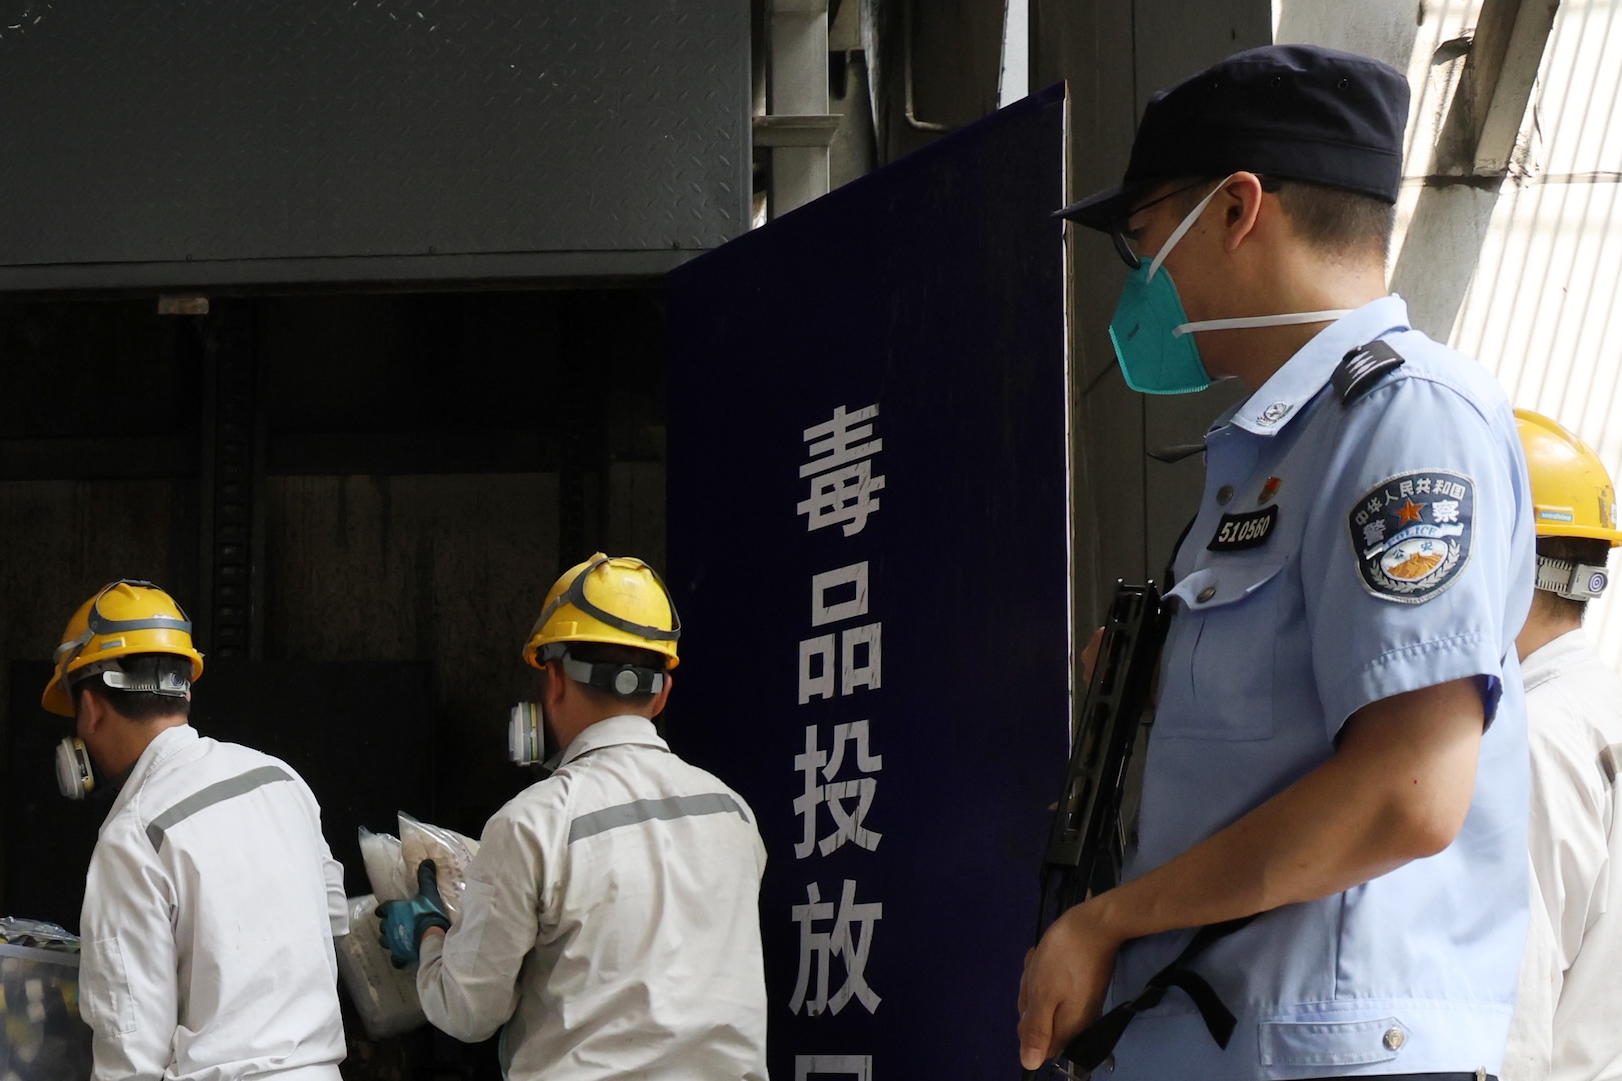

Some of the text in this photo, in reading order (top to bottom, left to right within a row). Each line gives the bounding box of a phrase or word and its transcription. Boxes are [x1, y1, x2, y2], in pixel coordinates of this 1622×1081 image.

[1355, 477, 1466, 526] 中华人民共和国
[1218, 515, 1271, 543] 510560
